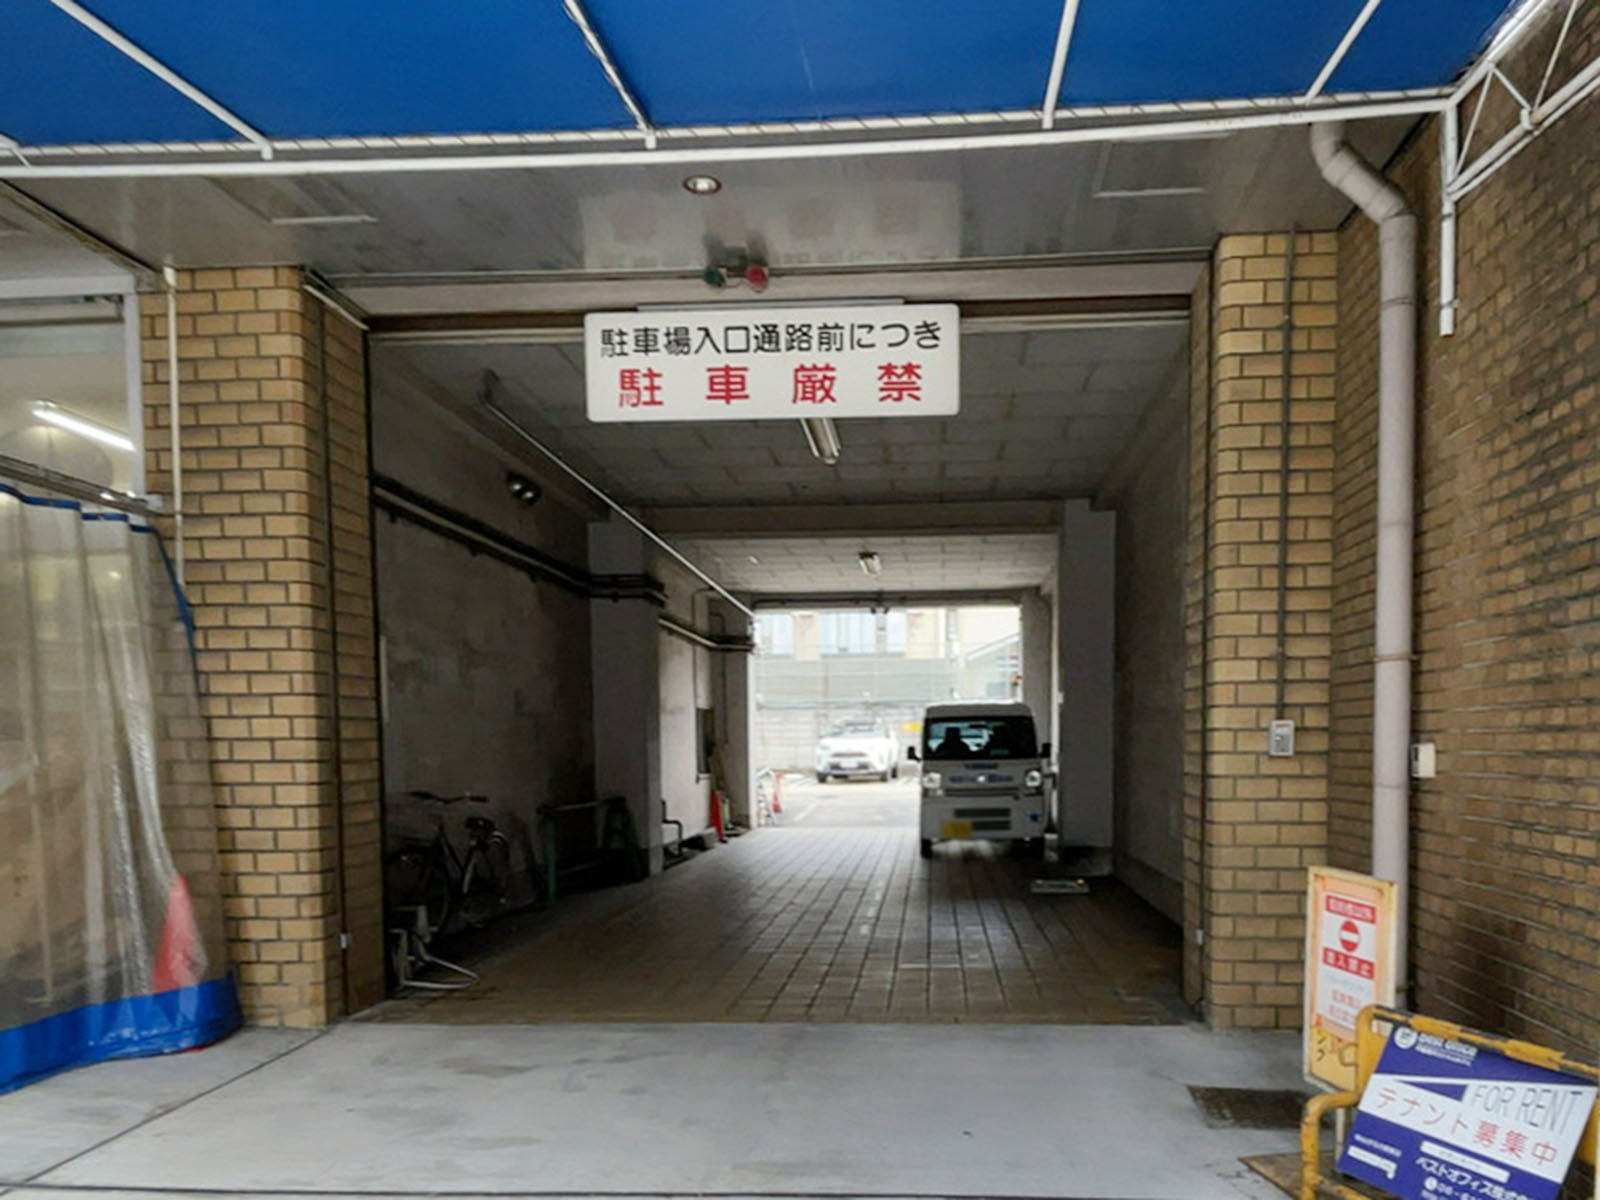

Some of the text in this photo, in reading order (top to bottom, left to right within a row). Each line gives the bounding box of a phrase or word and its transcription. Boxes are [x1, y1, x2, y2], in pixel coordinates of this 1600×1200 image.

[600, 320, 942, 358] 駐車場入口通路前につき
[618, 362, 923, 408] 駐車厳禁
[1378, 1086, 1558, 1166] テナント募集中
[1471, 1084, 1584, 1135] FOR RENT
